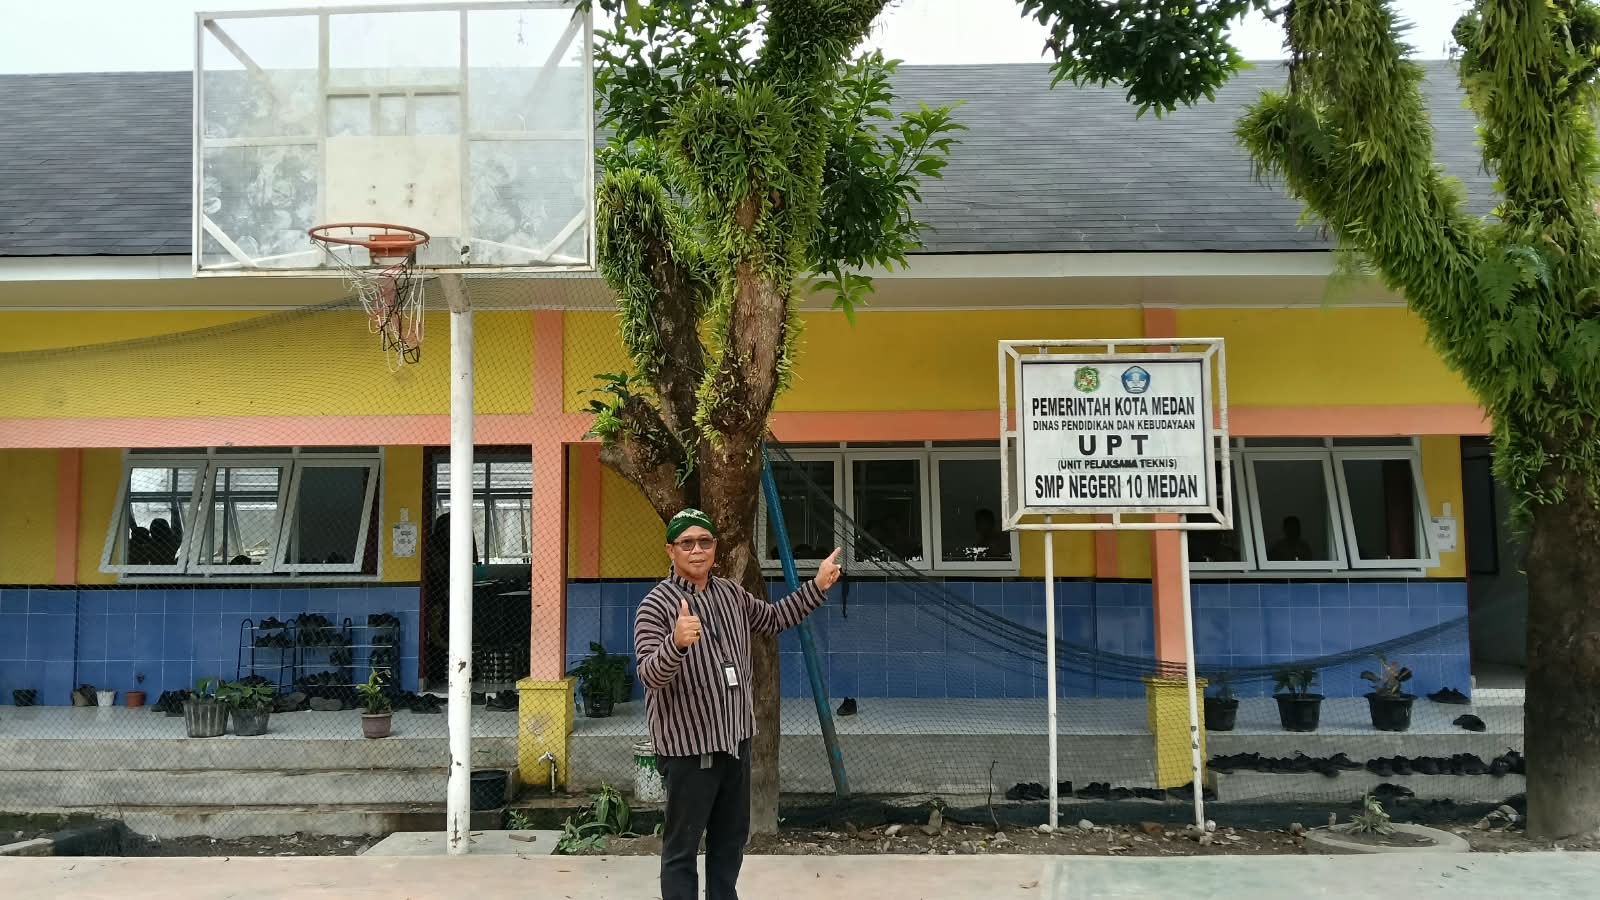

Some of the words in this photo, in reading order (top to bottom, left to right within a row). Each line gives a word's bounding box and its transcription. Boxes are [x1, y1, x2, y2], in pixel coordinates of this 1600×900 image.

[1032, 397, 1111, 416] PEMERINTAH
[1115, 397, 1148, 415] KOTA
[1151, 396, 1195, 415] MEDAN
[1033, 420, 1059, 431] DINAS
[1061, 420, 1114, 431] PENDIDIKAN
[1117, 420, 1135, 430] DAN
[1137, 419, 1195, 430] KEBUDAYAAN
[1057, 459, 1082, 472] (UNIT
[1139, 458, 1177, 470] TEKNIS)
[1035, 474, 1064, 498] SMP
[1069, 474, 1121, 498] NEGERI
[1126, 474, 1143, 498] 10
[1147, 474, 1198, 498] MEDAN
